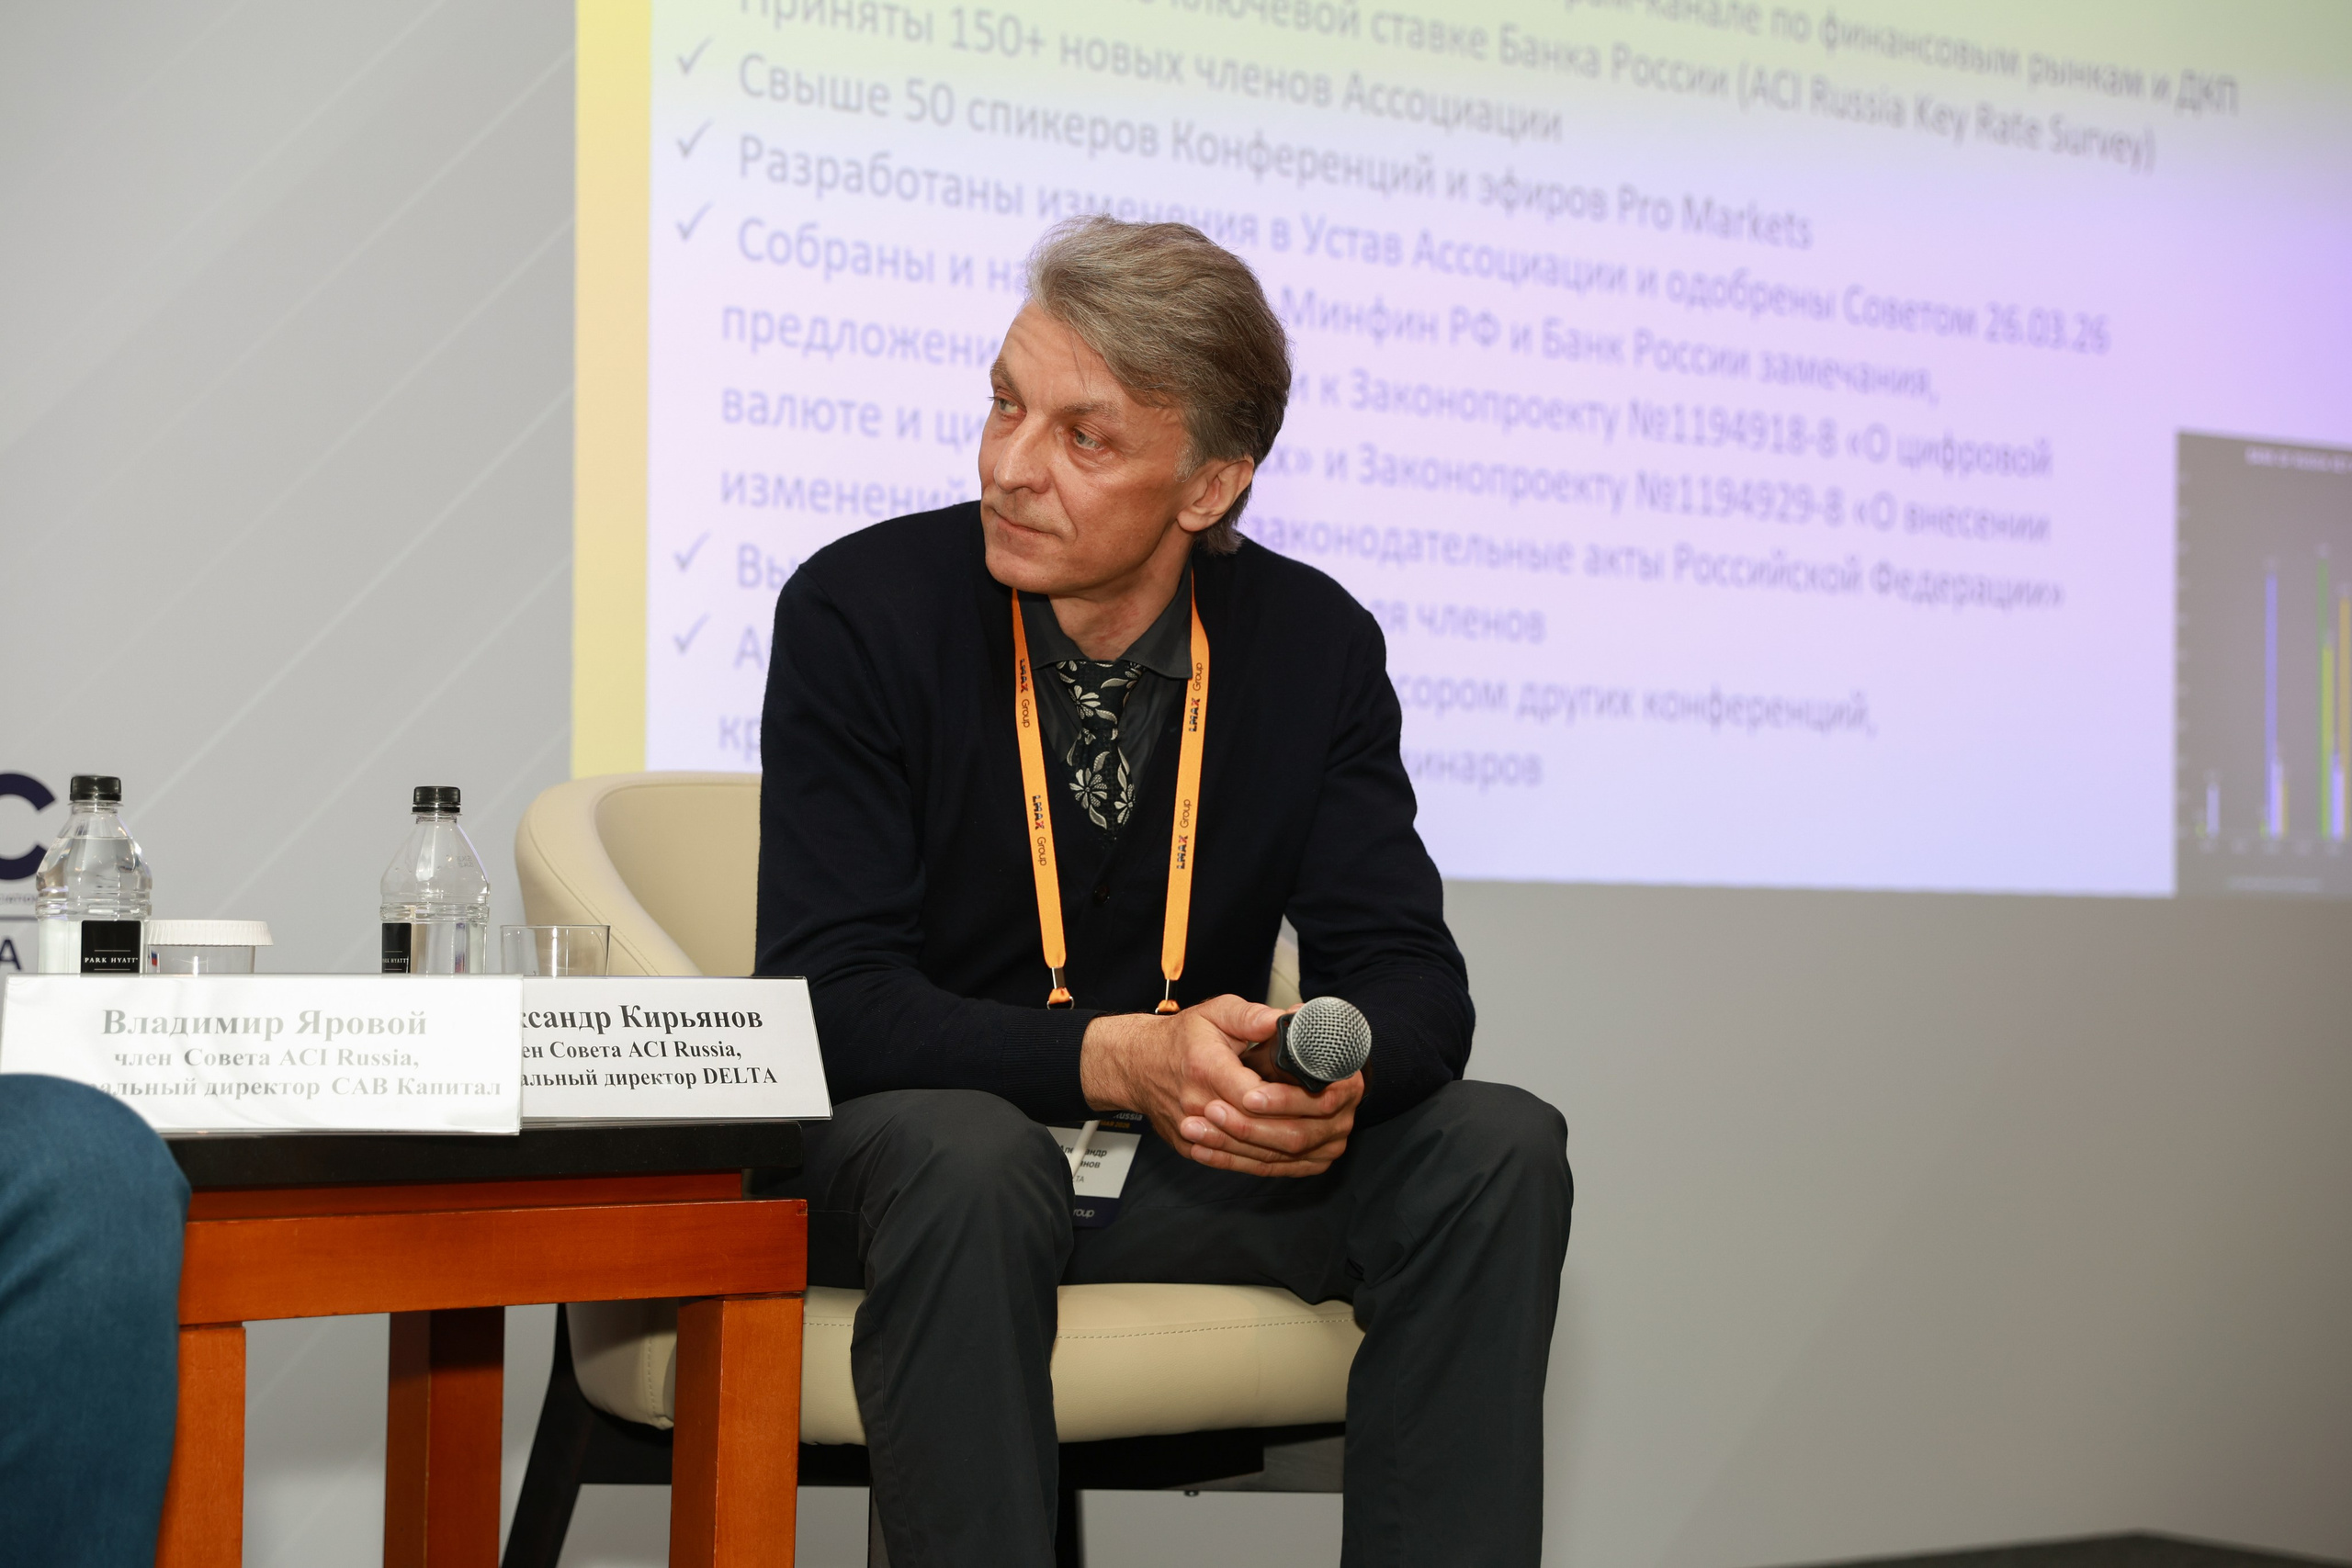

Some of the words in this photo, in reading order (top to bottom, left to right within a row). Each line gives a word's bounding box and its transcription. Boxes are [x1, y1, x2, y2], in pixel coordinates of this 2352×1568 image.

[1770, 5, 1814, 45] по
[1817, 5, 2021, 80] финансовым
[948, 6, 1046, 59] 150+
[1059, 31, 1185, 86] новых
[1194, 53, 1333, 108] членов
[1341, 69, 1563, 145] Ассоциации
[1370, 9, 1489, 61] ставке
[1498, 21, 1601, 79] Банка
[1611, 40, 1729, 100] России
[1809, 73, 1907, 129] Russia
[1914, 89, 1970, 148] Key
[1975, 99, 2044, 151] Rate
[739, 52, 892, 118] Свыше
[904, 76, 956, 128] 50
[967, 96, 1160, 158] спикеров
[1170, 117, 1437, 201] Конференций
[1446, 167, 1469, 202] и
[1477, 165, 1609, 224] эфиров
[1618, 183, 1675, 232] Pro
[1680, 192, 1814, 252] Markets
[738, 216, 935, 284] Собраны
[948, 252, 975, 288] и
[739, 133, 1024, 217] Разработаны
[1269, 215, 1292, 253] в
[1300, 211, 1404, 267] Устав
[1411, 228, 1629, 298] Ассоциации
[1635, 265, 1659, 300] и
[1666, 266, 1838, 322] одобрены
[1842, 283, 1979, 339] Советом
[1983, 299, 2111, 356] 26.03.26
[721, 304, 997, 365] предложени
[1281, 284, 1440, 350] Минфин
[1449, 303, 1503, 347] РФ
[1510, 321, 1533, 355] и
[1542, 314, 1626, 367] Банк
[1634, 325, 1750, 380] России
[721, 387, 883, 439] валюте
[895, 405, 922, 442] и
[1318, 374, 1342, 408] к
[1349, 366, 1622, 446] Законопроекту
[1628, 396, 1838, 459] №1194918-8
[1896, 427, 2054, 480] цифровой
[1323, 446, 1349, 481] и
[1356, 441, 1628, 518] Законопроекту
[1634, 468, 1846, 529] №1194929-8
[1902, 499, 2053, 545] внесении
[1583, 542, 1666, 583] акты
[1672, 541, 1865, 595] Российской
[1416, 603, 1547, 645] членов
[1192, 662, 1203, 692] Group
[1021, 698, 1031, 728] Group
[1189, 698, 1201, 732] LMAX
[1515, 681, 1635, 728] других
[1032, 795, 1046, 830] LMAX
[1179, 798, 1192, 829] Group
[1036, 836, 1047, 866] Group
[1176, 834, 1189, 870] LMAX
[101, 1010, 285, 1042] Владимир
[296, 1010, 427, 1042] Яровой
[617, 1005, 763, 1035] Кирьянов
[114, 1052, 173, 1067] член
[184, 1048, 271, 1067] Совета
[279, 1049, 328, 1067] ACI
[336, 1048, 420, 1069] Russia,
[549, 1041, 622, 1058] Совета
[628, 1041, 668, 1058] ACI
[674, 1041, 741, 1061] Russia,
[204, 1080, 321, 1100] директор
[397, 1077, 502, 1097] Капитал
[520, 1068, 598, 1087] альный
[604, 1072, 697, 1090] директор
[703, 1066, 778, 1085] DELTA
